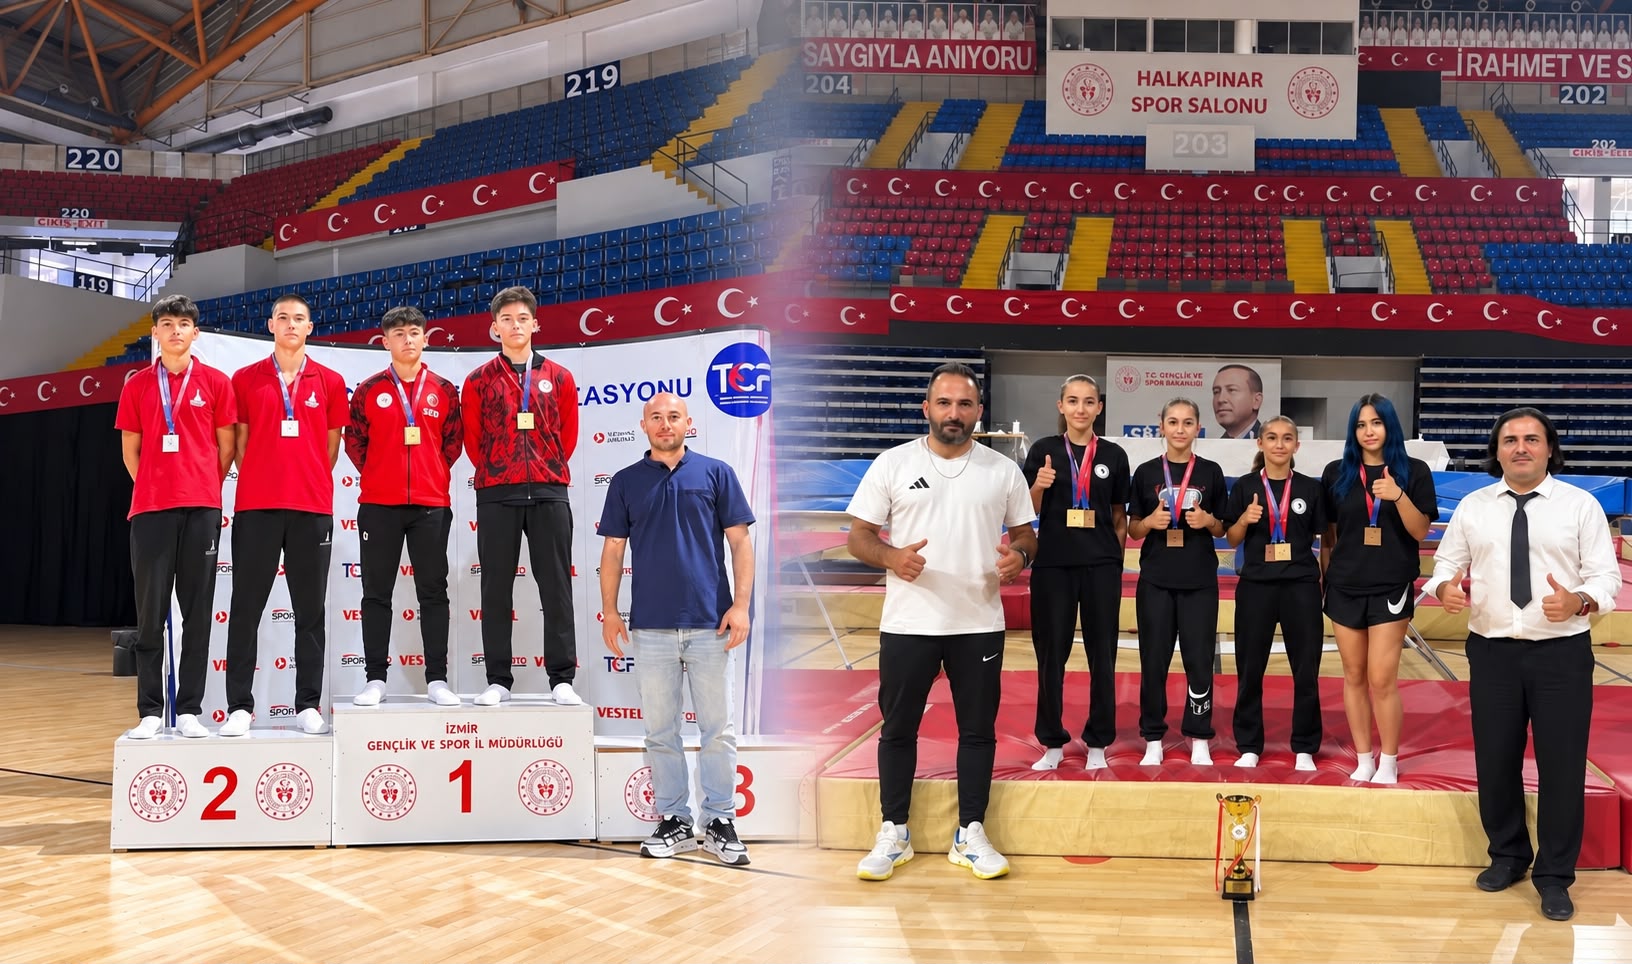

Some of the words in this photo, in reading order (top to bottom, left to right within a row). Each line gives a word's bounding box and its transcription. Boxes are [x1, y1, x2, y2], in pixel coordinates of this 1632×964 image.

[804, 42, 921, 68] SAYGIYLA
[926, 44, 1033, 71] ANIYORU
[1578, 54, 1612, 78] VE
[566, 64, 619, 99] 219
[805, 74, 850, 95] 204
[1137, 70, 1263, 88] HALKAPINAR
[1560, 85, 1606, 105] 202
[1131, 96, 1183, 113] SPOR
[1188, 97, 1268, 114] SALONU
[1174, 133, 1227, 155] 203
[1591, 139, 1617, 150] 202
[67, 147, 120, 171] 220
[61, 208, 90, 219] 220
[78, 274, 109, 293] 119
[711, 362, 771, 394] TCF
[578, 377, 692, 407] ASYONU
[342, 563, 361, 578] TC
[399, 654, 424, 666] VES
[603, 656, 635, 673] TCF
[597, 706, 643, 720] VESTEL
[446, 721, 479, 734] İZMİR
[367, 737, 417, 753] GENÇLİK
[421, 740, 435, 750] VE
[440, 739, 470, 749] SPOR
[475, 736, 484, 749] İL
[488, 736, 564, 749] MÜDÜRLÜĞÜ
[200, 766, 238, 821] 2
[448, 759, 472, 814] 1
